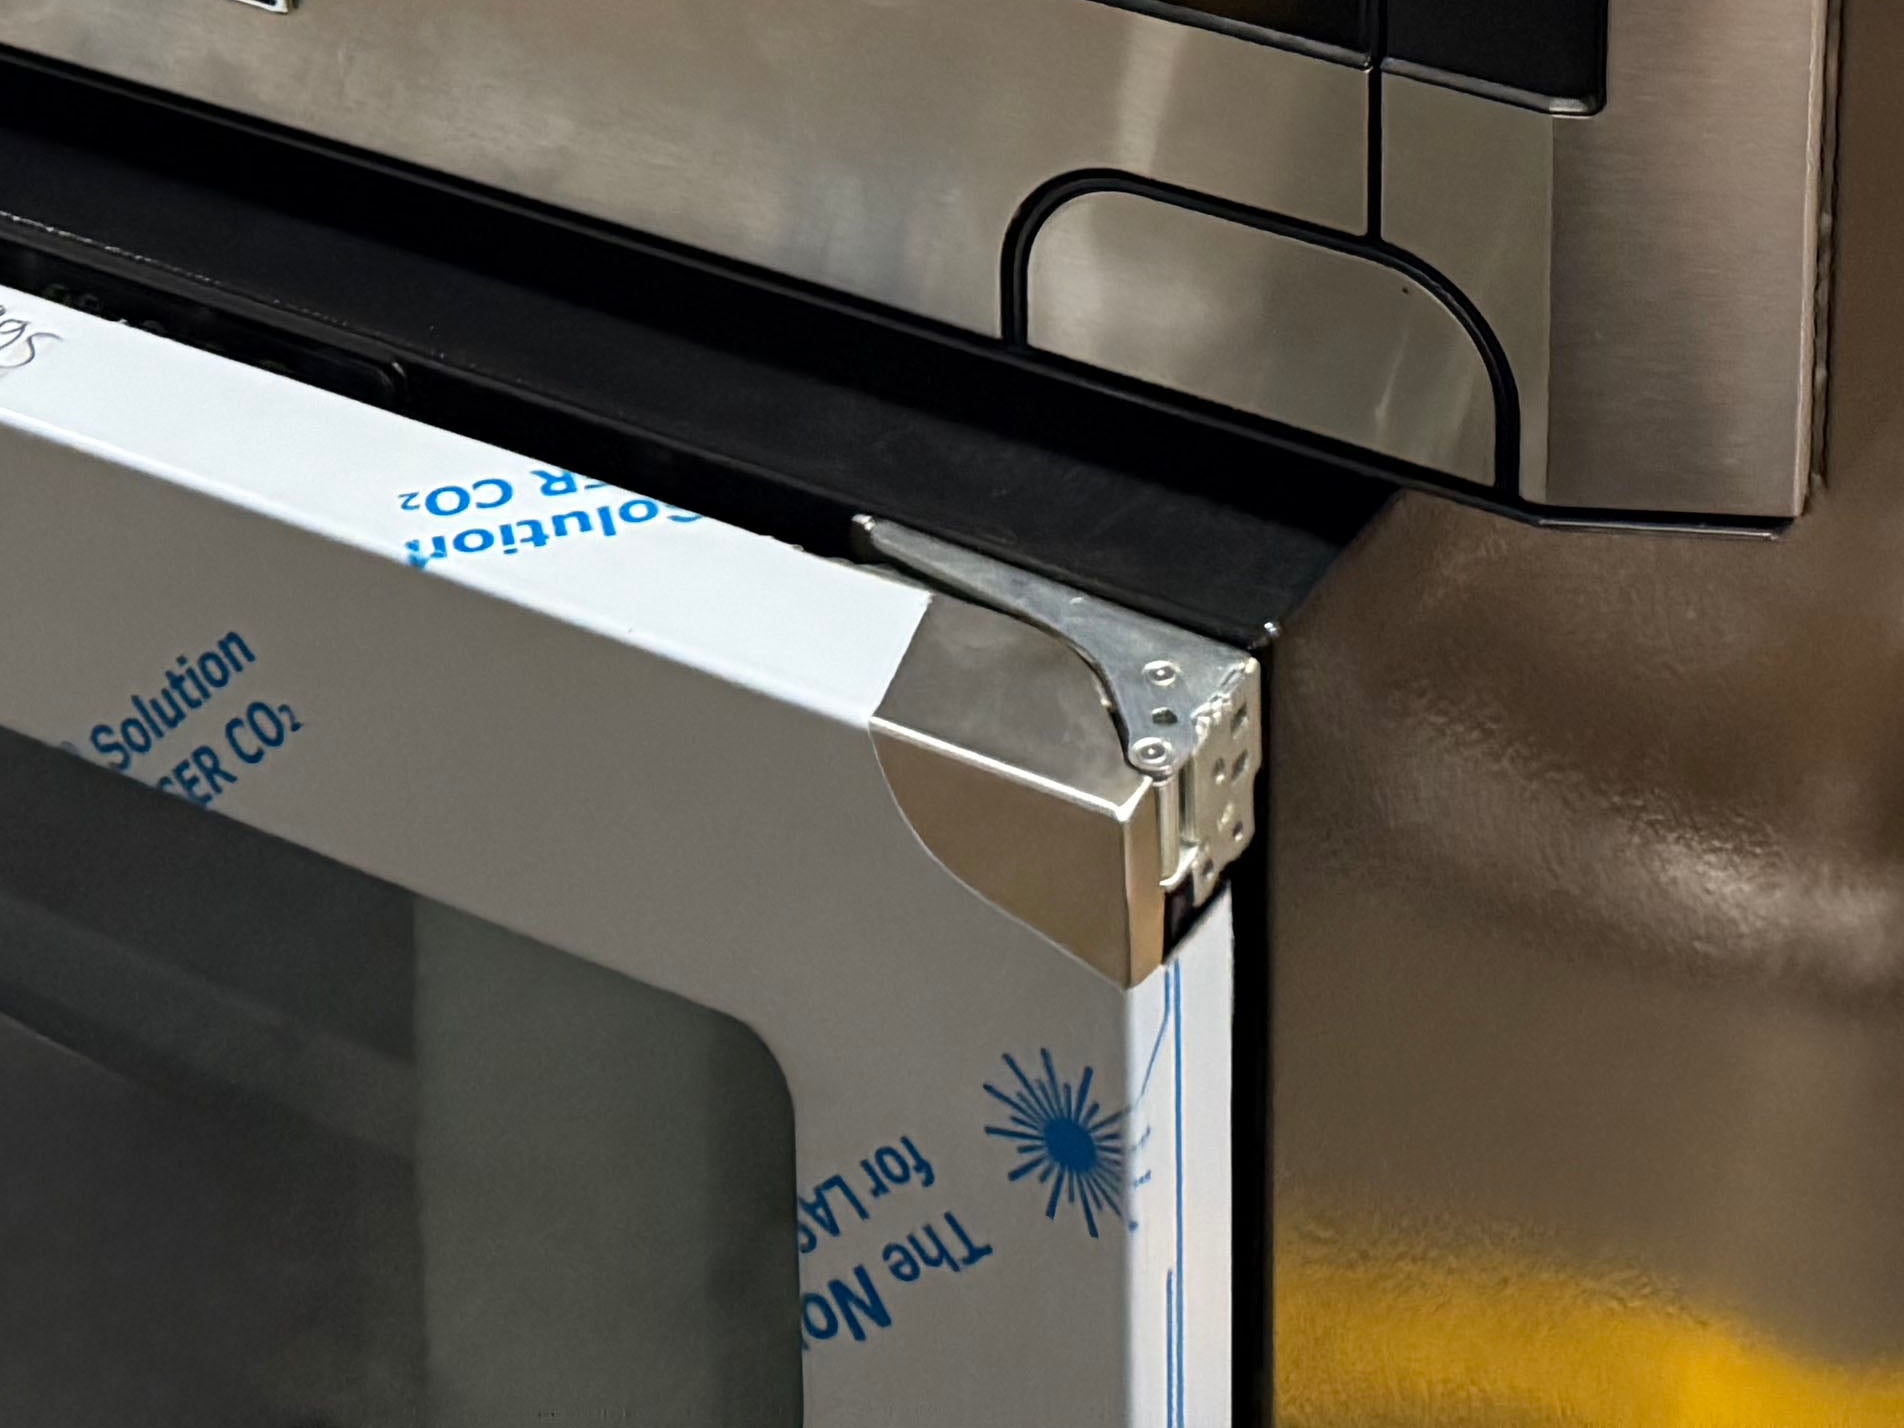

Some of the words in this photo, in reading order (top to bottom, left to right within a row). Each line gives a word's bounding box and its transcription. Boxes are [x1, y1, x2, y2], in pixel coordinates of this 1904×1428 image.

[90, 631, 257, 771] Solution
[859, 1134, 935, 1198] for
[881, 1210, 993, 1283] The
